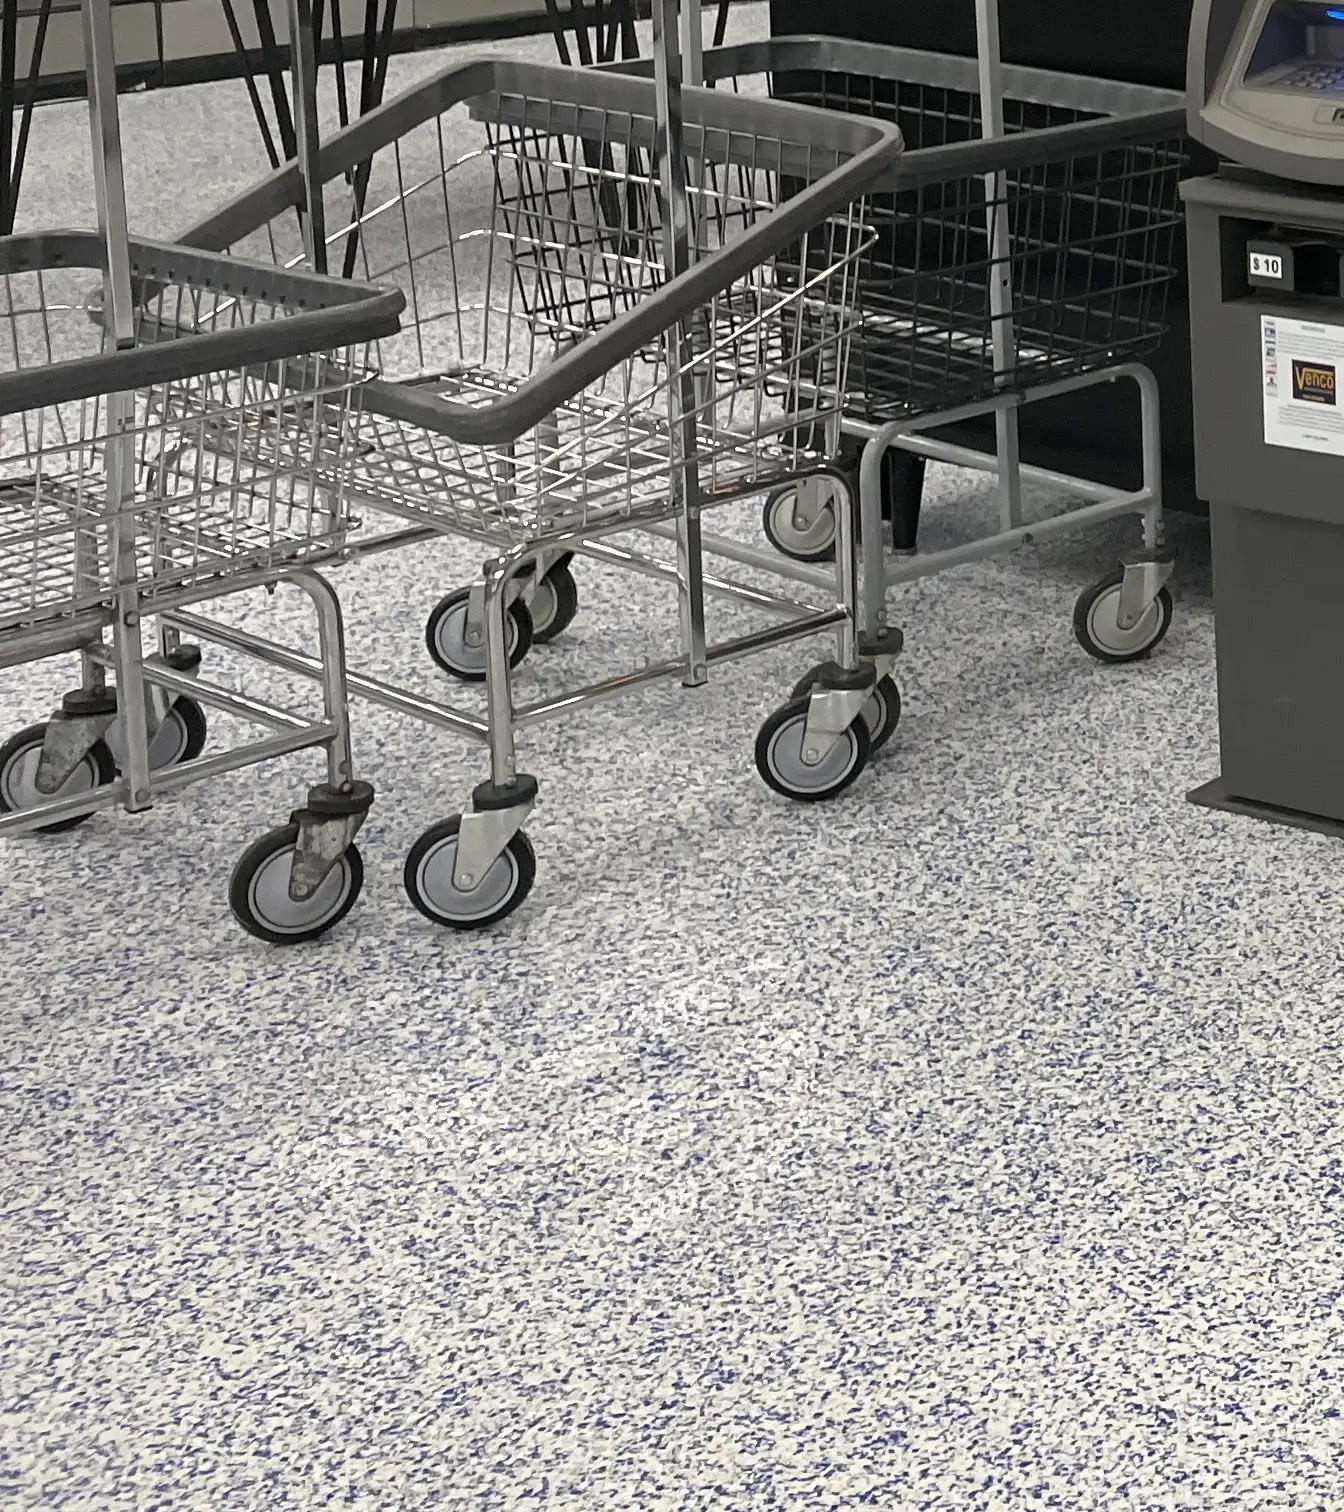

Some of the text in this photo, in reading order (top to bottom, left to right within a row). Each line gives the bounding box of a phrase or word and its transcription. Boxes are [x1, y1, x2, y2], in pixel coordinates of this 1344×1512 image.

[1253, 257, 1279, 274] $ 10
[1295, 366, 1334, 390] Venco
